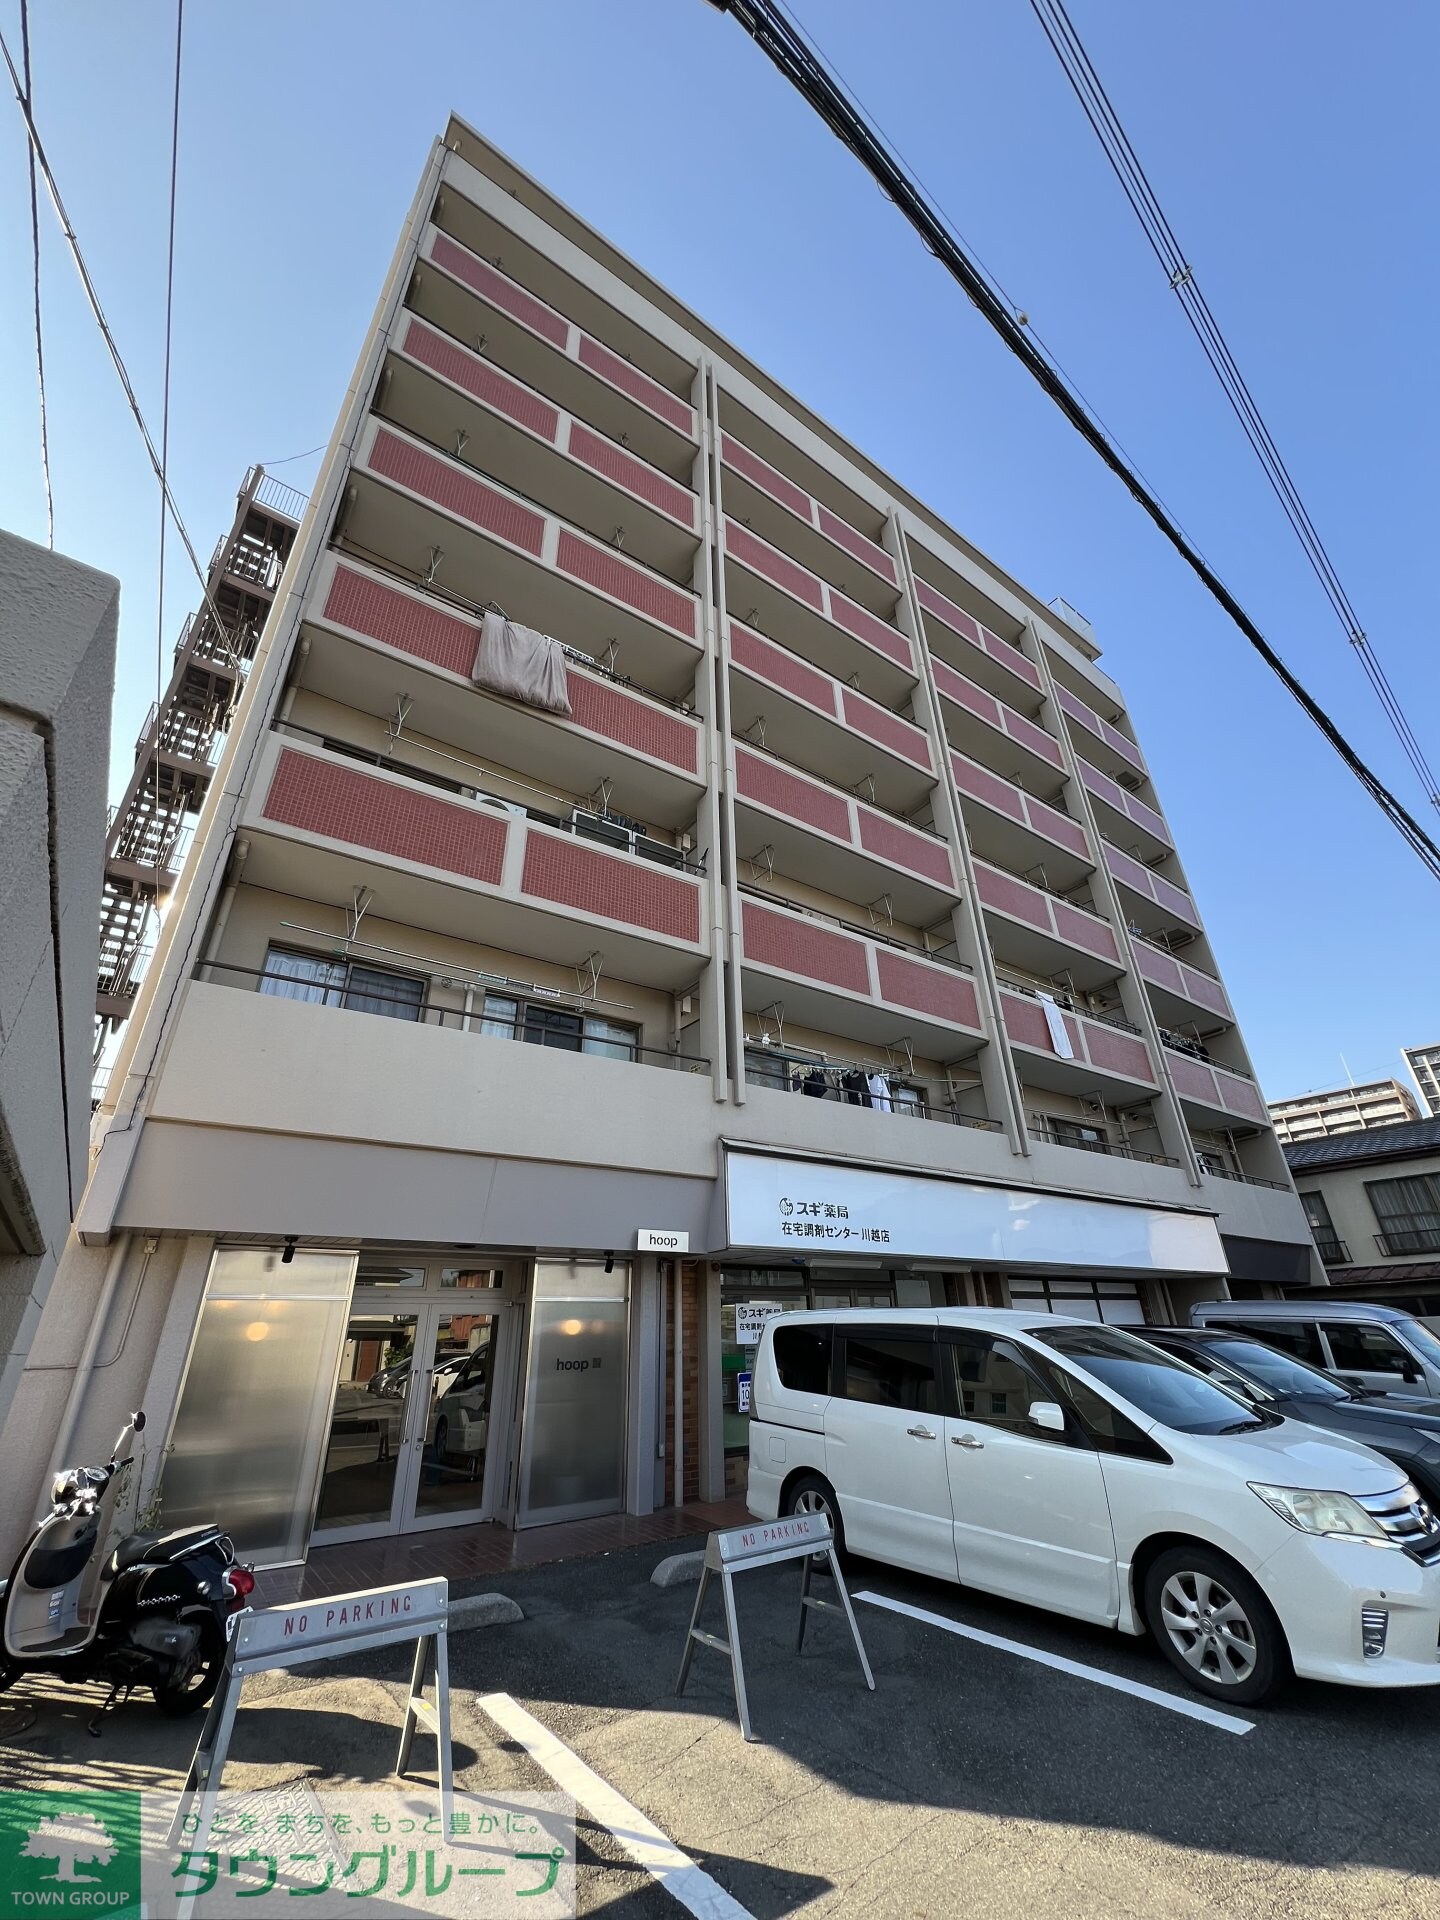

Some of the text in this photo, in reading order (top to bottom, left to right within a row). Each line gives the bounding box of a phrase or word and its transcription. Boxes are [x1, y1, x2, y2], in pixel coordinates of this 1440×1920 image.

[796, 1202, 849, 1219] スギ薬局
[649, 1234, 678, 1248] hoop
[556, 1358, 589, 1372] hoop
[742, 1521, 810, 1547] NO PARKING
[284, 1595, 411, 1636] NO PARKING
